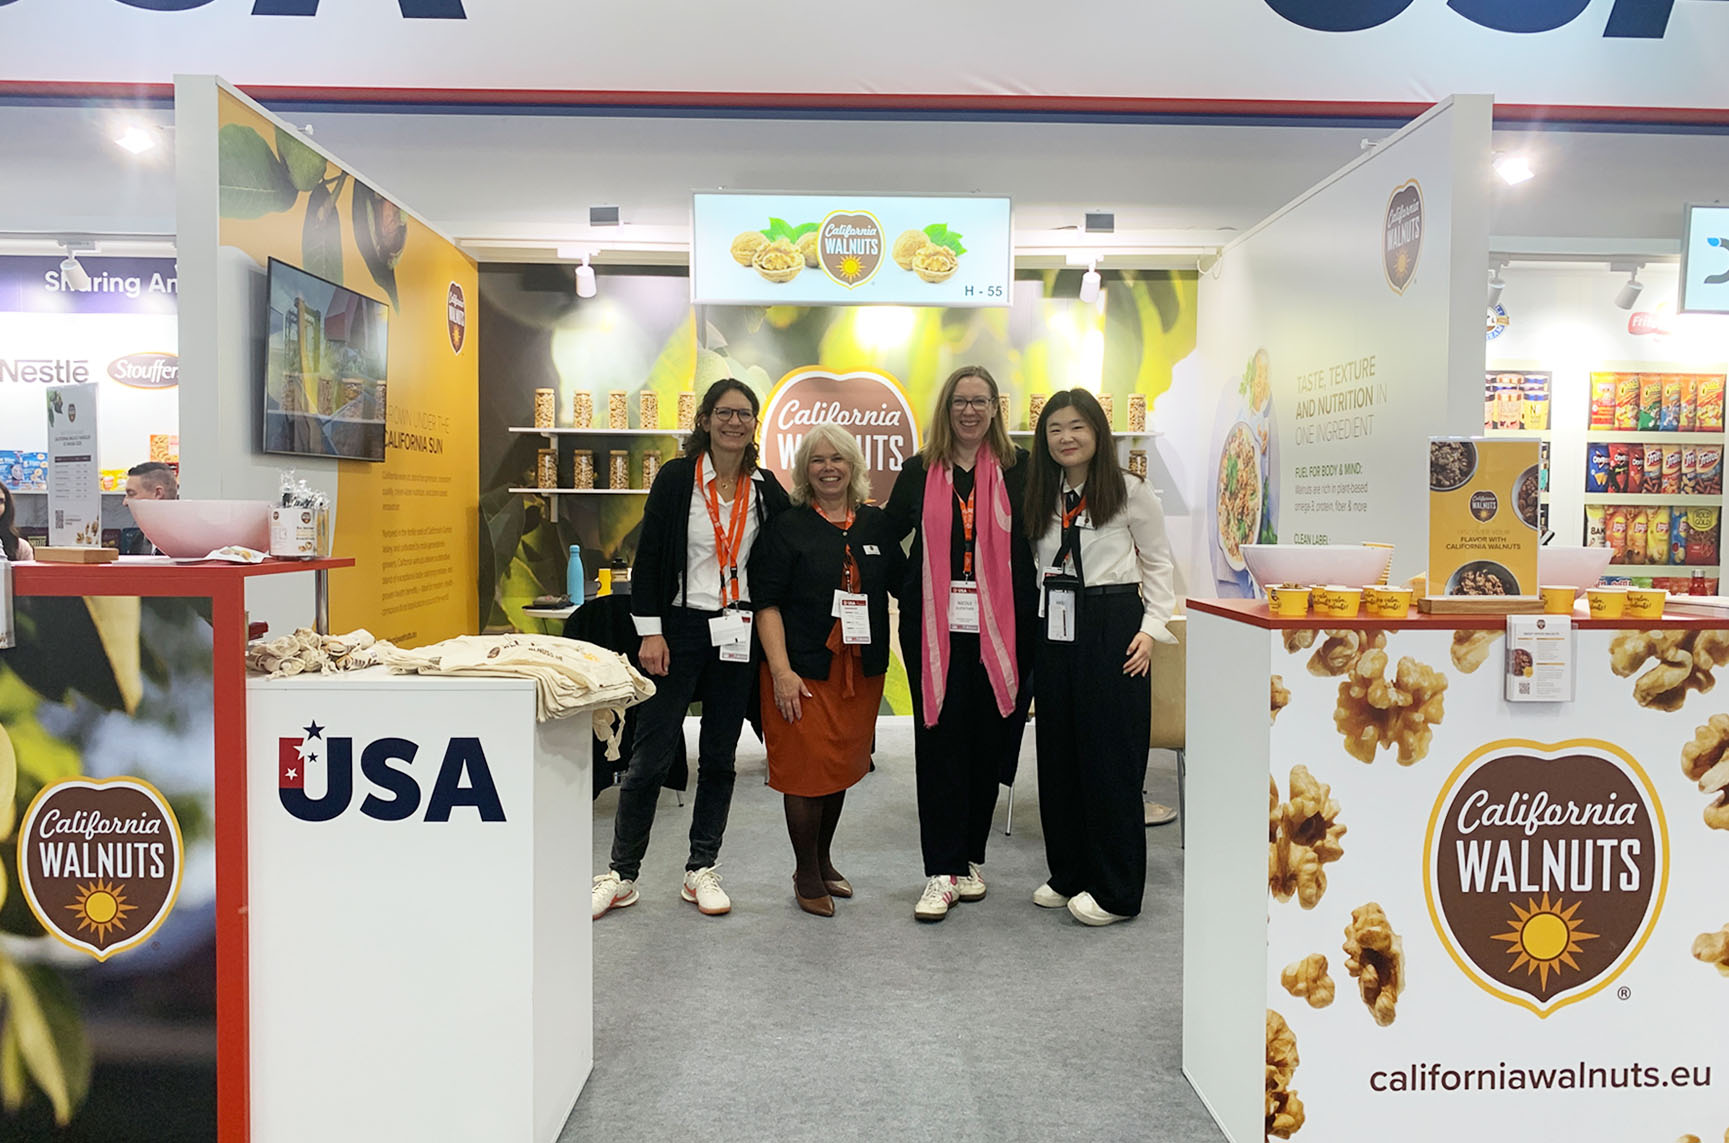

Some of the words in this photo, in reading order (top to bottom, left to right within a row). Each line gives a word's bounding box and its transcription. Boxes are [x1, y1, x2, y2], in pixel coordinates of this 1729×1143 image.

[824, 223, 878, 239] California
[824, 237, 878, 256] WALNUTS
[964, 285, 974, 297] H
[987, 285, 1003, 297] 55
[1328, 355, 1376, 387] TEXTURE
[777, 399, 902, 431] California
[1296, 398, 1316, 420] AND
[1317, 385, 1374, 416] NUTRITION
[1317, 413, 1375, 443] INGREDIENT
[1309, 465, 1320, 477] FOR
[278, 735, 508, 823] USA
[39, 808, 161, 840] California
[1456, 788, 1639, 837] California
[38, 841, 165, 879] WALNUTS
[1455, 837, 1642, 893] WALNUTS
[1369, 1061, 1713, 1093] californiawalnuts.eu
